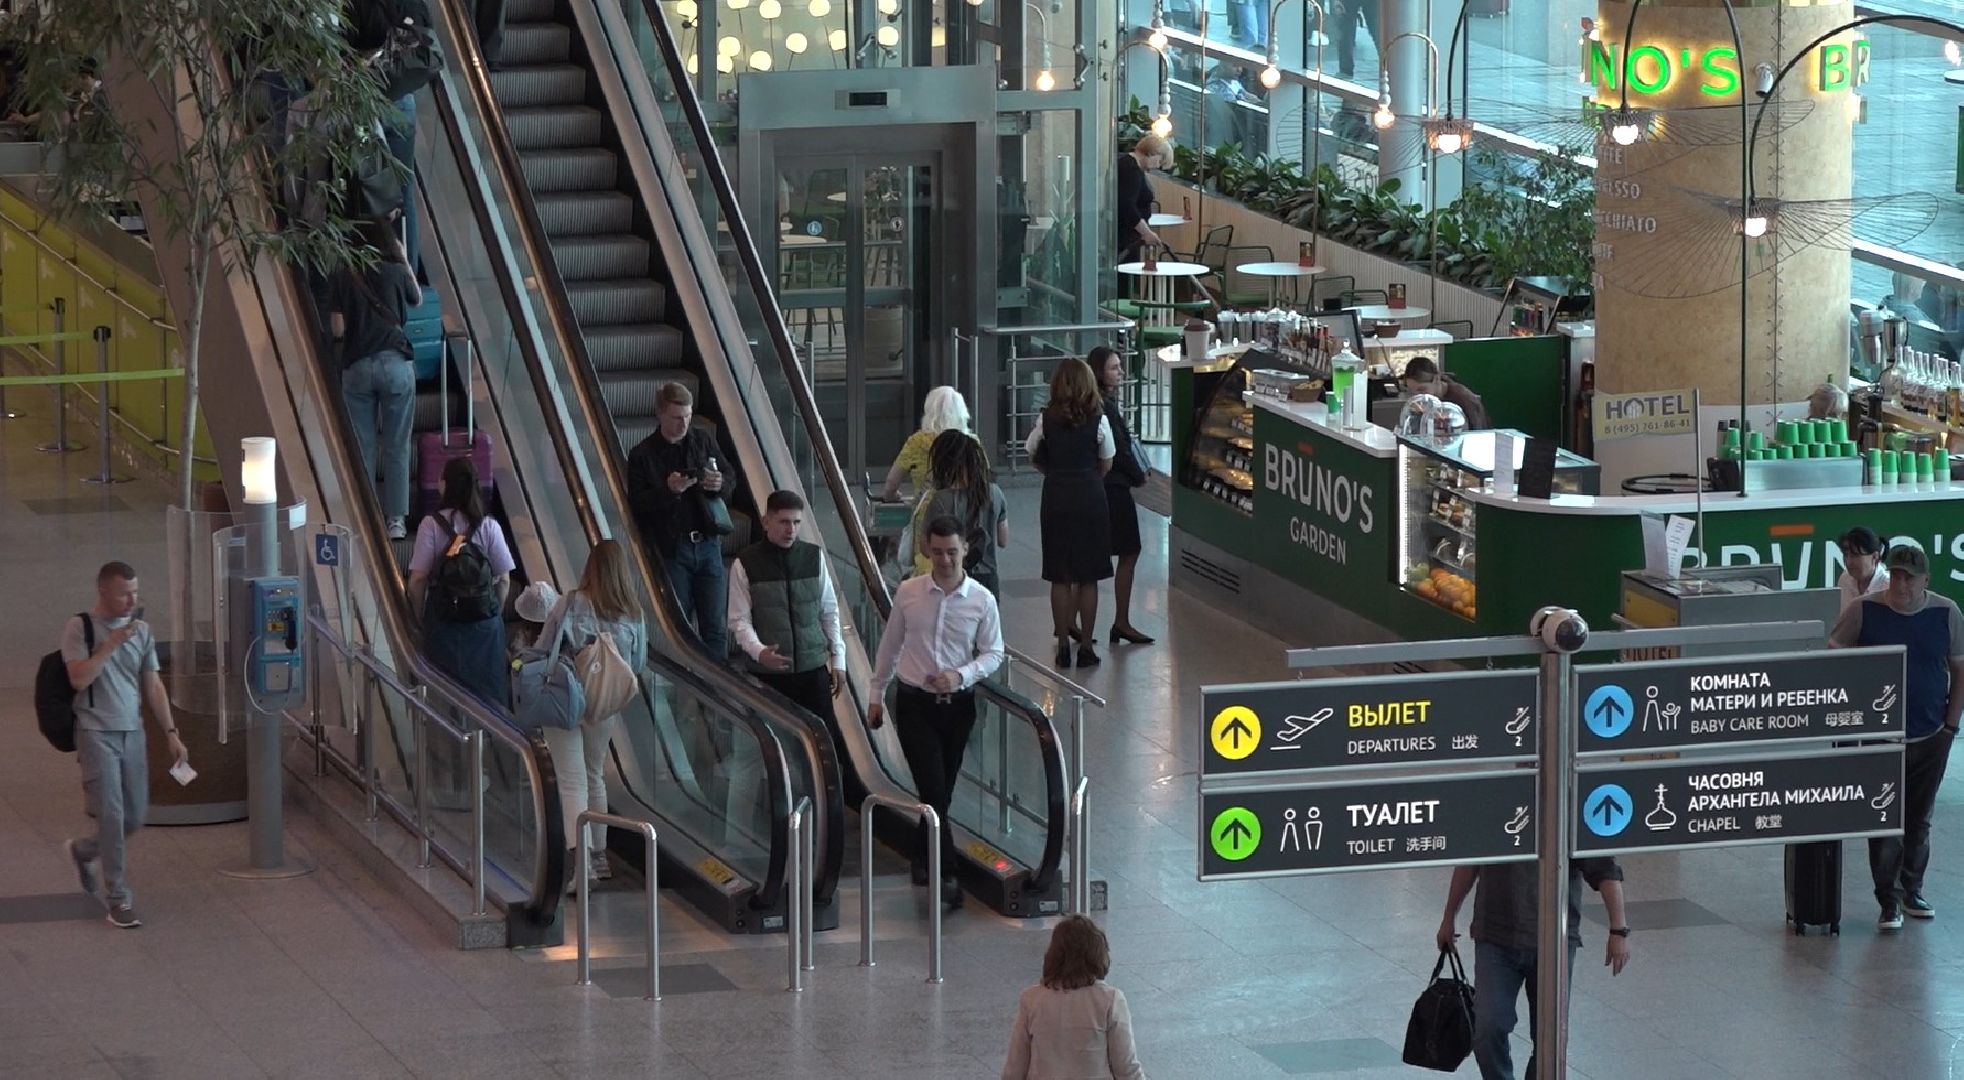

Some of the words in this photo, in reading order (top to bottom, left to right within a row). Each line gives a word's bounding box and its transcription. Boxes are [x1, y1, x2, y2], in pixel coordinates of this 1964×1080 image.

[1588, 44, 1740, 96] NO'S
[1605, 395, 1690, 419] HOTEL
[1265, 442, 1373, 534] BRUNO'S
[1290, 516, 1346, 565] GARDEN
[1690, 672, 1771, 692] КОМНАТА
[1690, 693, 1756, 712] МАТЕРИ
[1761, 693, 1773, 708] И
[1777, 688, 1849, 707] РЕБЕНКА
[1349, 701, 1431, 728] ВЫЛЕТ
[1690, 718, 1726, 734] BABY
[1730, 716, 1764, 732] CARE
[1767, 714, 1809, 730] ROOM
[1881, 713, 1888, 725] 2
[1347, 736, 1437, 755] DEPARTURES
[1451, 735, 1479, 750] 出发
[1515, 736, 1523, 747] 2
[1688, 771, 1764, 791] ЧАСОВНЯ
[1688, 791, 1781, 812] АРХАНГЕЛА
[1785, 785, 1864, 805] МИХАИЛА
[1346, 801, 1440, 827] ТУАЛЕТ
[1880, 811, 1887, 822] 2
[1688, 817, 1741, 833] CHAPEL
[1346, 838, 1395, 855] TOILET
[1406, 836, 1447, 852] 洗手间
[1514, 835, 1521, 847] 2
